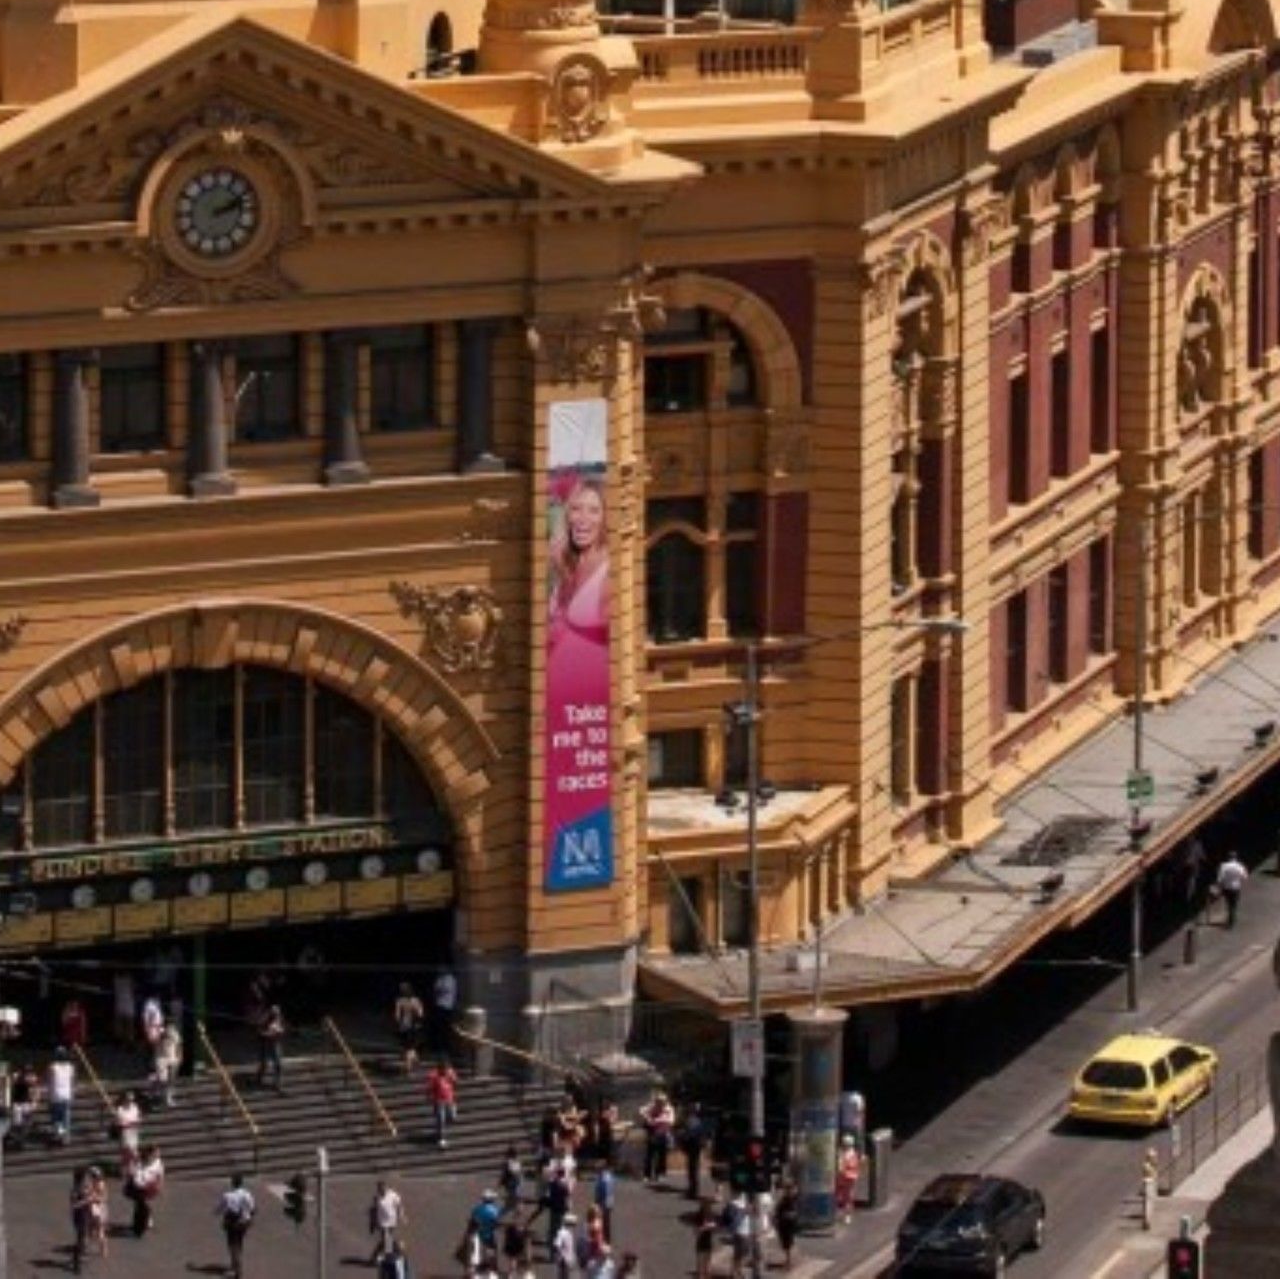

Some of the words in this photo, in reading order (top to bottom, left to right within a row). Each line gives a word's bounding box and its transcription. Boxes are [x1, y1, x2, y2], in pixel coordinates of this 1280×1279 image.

[563, 704, 607, 724] Take
[553, 730, 582, 748] me
[586, 727, 607, 745] to
[575, 749, 607, 767] the
